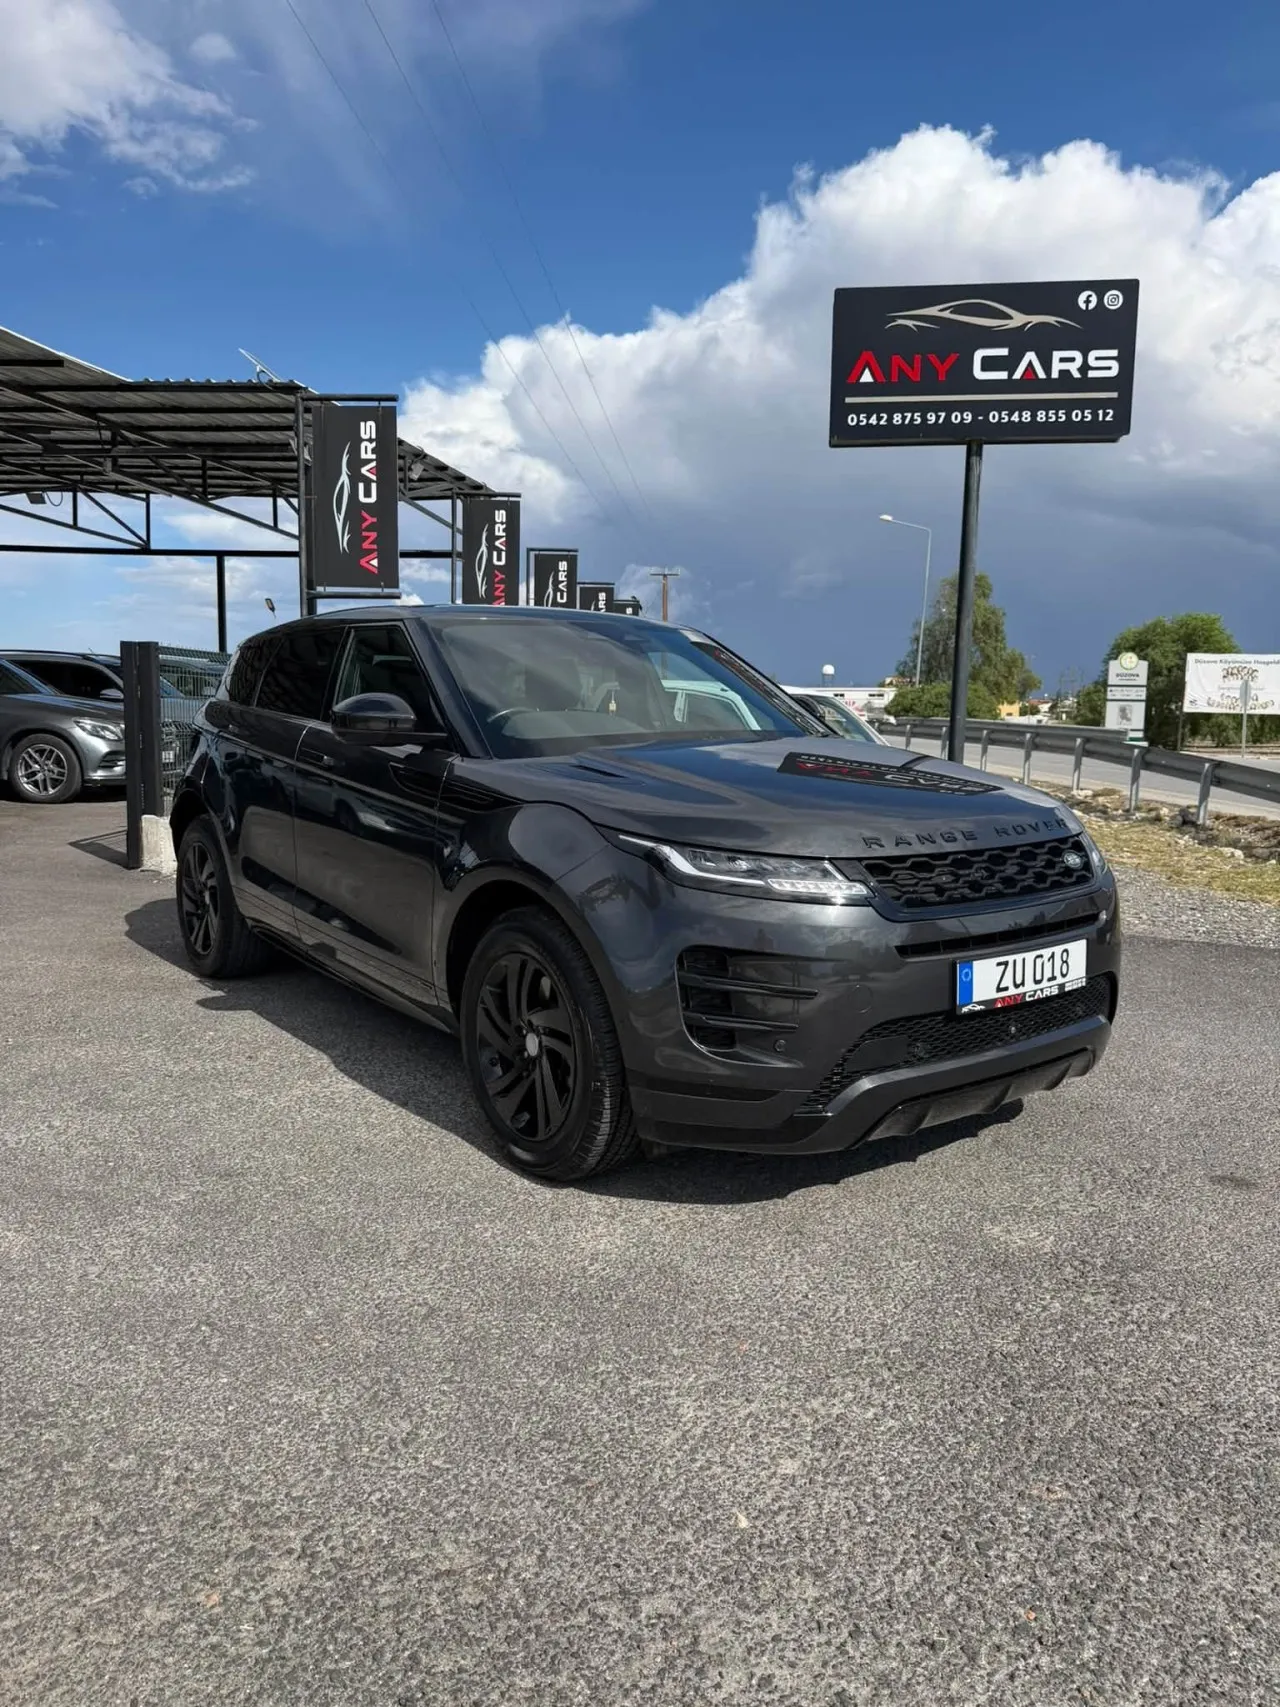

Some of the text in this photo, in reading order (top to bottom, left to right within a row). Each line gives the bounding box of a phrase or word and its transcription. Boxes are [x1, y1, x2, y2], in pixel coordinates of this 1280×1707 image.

[847, 347, 1119, 383] ANY CARS
[848, 413, 888, 426] 0542
[892, 412, 922, 425] 875
[927, 412, 946, 424] 97
[951, 411, 973, 424] 09
[989, 410, 1031, 423] 0548
[1036, 409, 1066, 422] 855
[1071, 409, 1092, 422] 05
[1097, 409, 1114, 421] 12
[358, 420, 379, 575] ANY CARS
[493, 509, 507, 566] CARS
[557, 560, 568, 604] CARS
[861, 817, 1069, 849] RANGE ROVER
[995, 948, 1070, 993] ZU 018
[994, 993, 1024, 1008] ANY
[1025, 985, 1059, 1002] CARS
